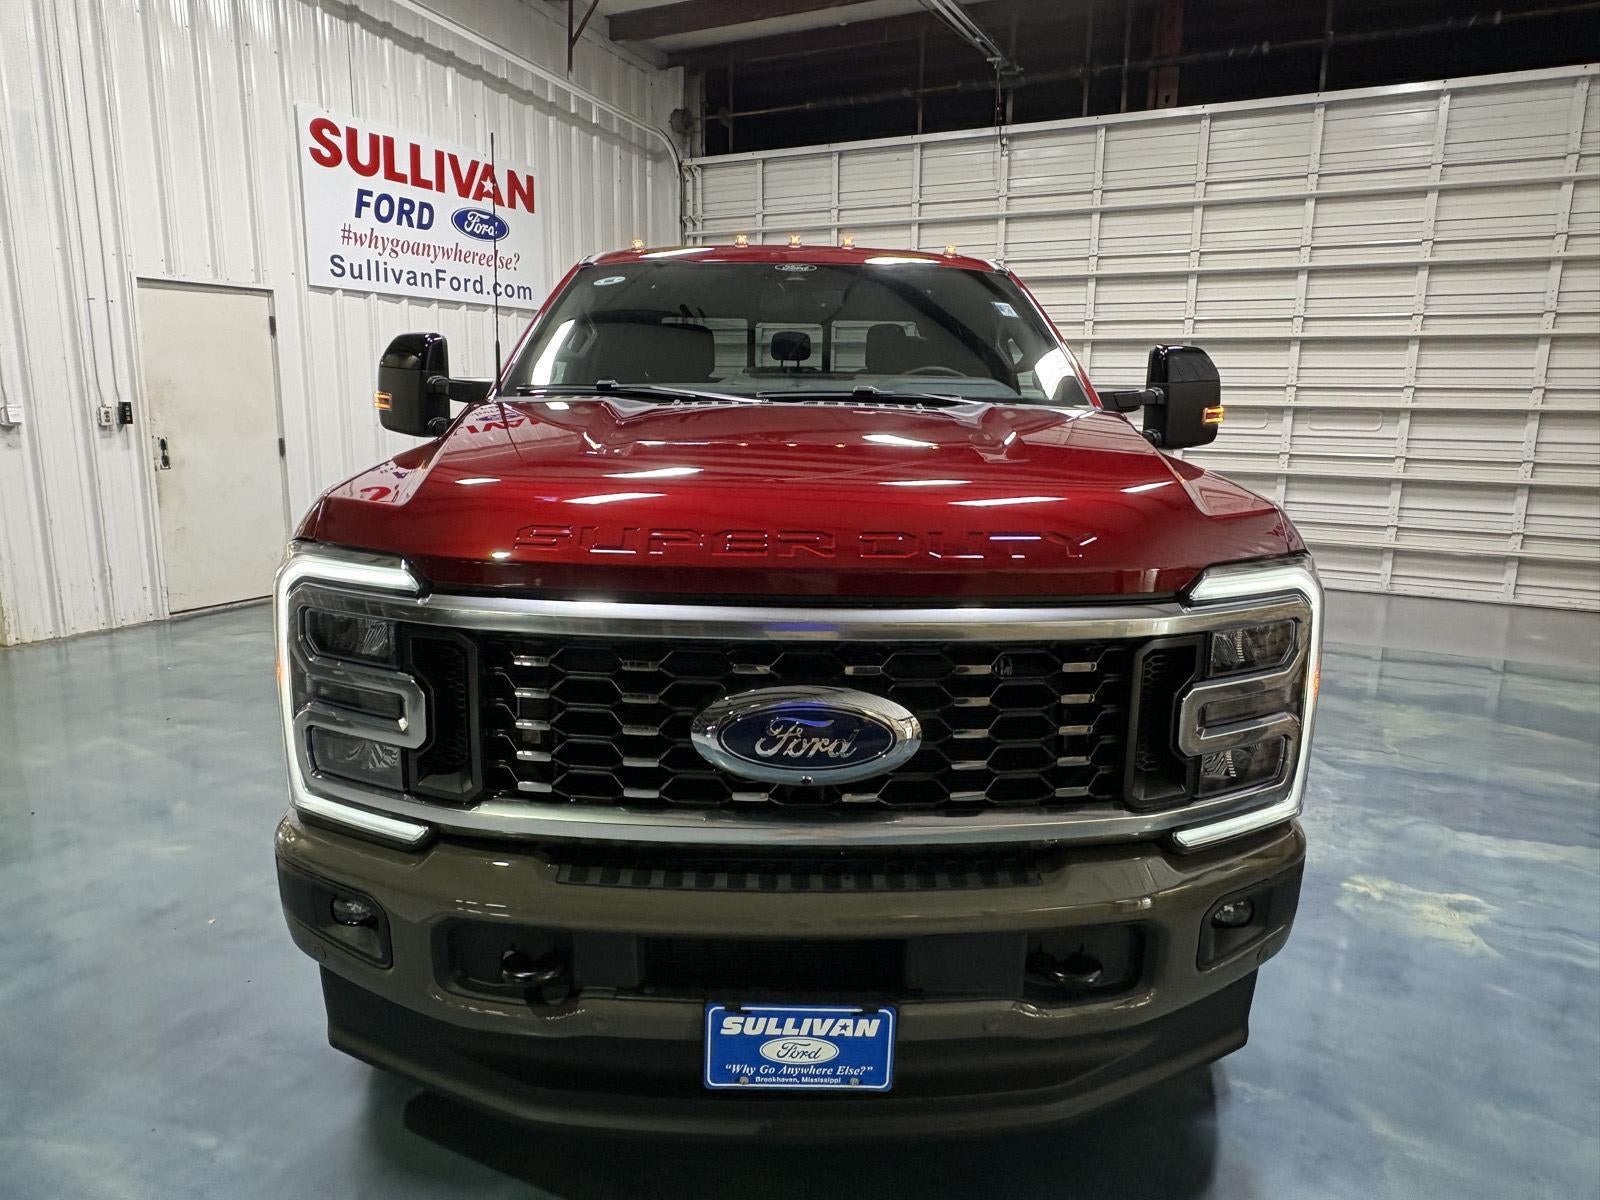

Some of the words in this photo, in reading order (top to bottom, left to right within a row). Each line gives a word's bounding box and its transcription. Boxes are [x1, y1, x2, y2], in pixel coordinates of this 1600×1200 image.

[309, 117, 535, 214] SULLIVAN
[354, 188, 435, 231] FORD
[464, 211, 499, 236] Ford
[340, 222, 521, 272] #whygoanywhereelse?
[329, 254, 533, 300] SullivanFord.com
[514, 525, 835, 558] SUPER
[859, 531, 1098, 559] DUTY
[754, 716, 860, 758] Ford
[720, 1016, 881, 1037] SULLIVAN
[776, 1041, 823, 1060] Ford
[755, 1076, 800, 1084] Brookhaven,
[801, 1076, 841, 1085] Mississippi
[760, 1064, 776, 1075] Go
[778, 1065, 834, 1076] Anywhere
